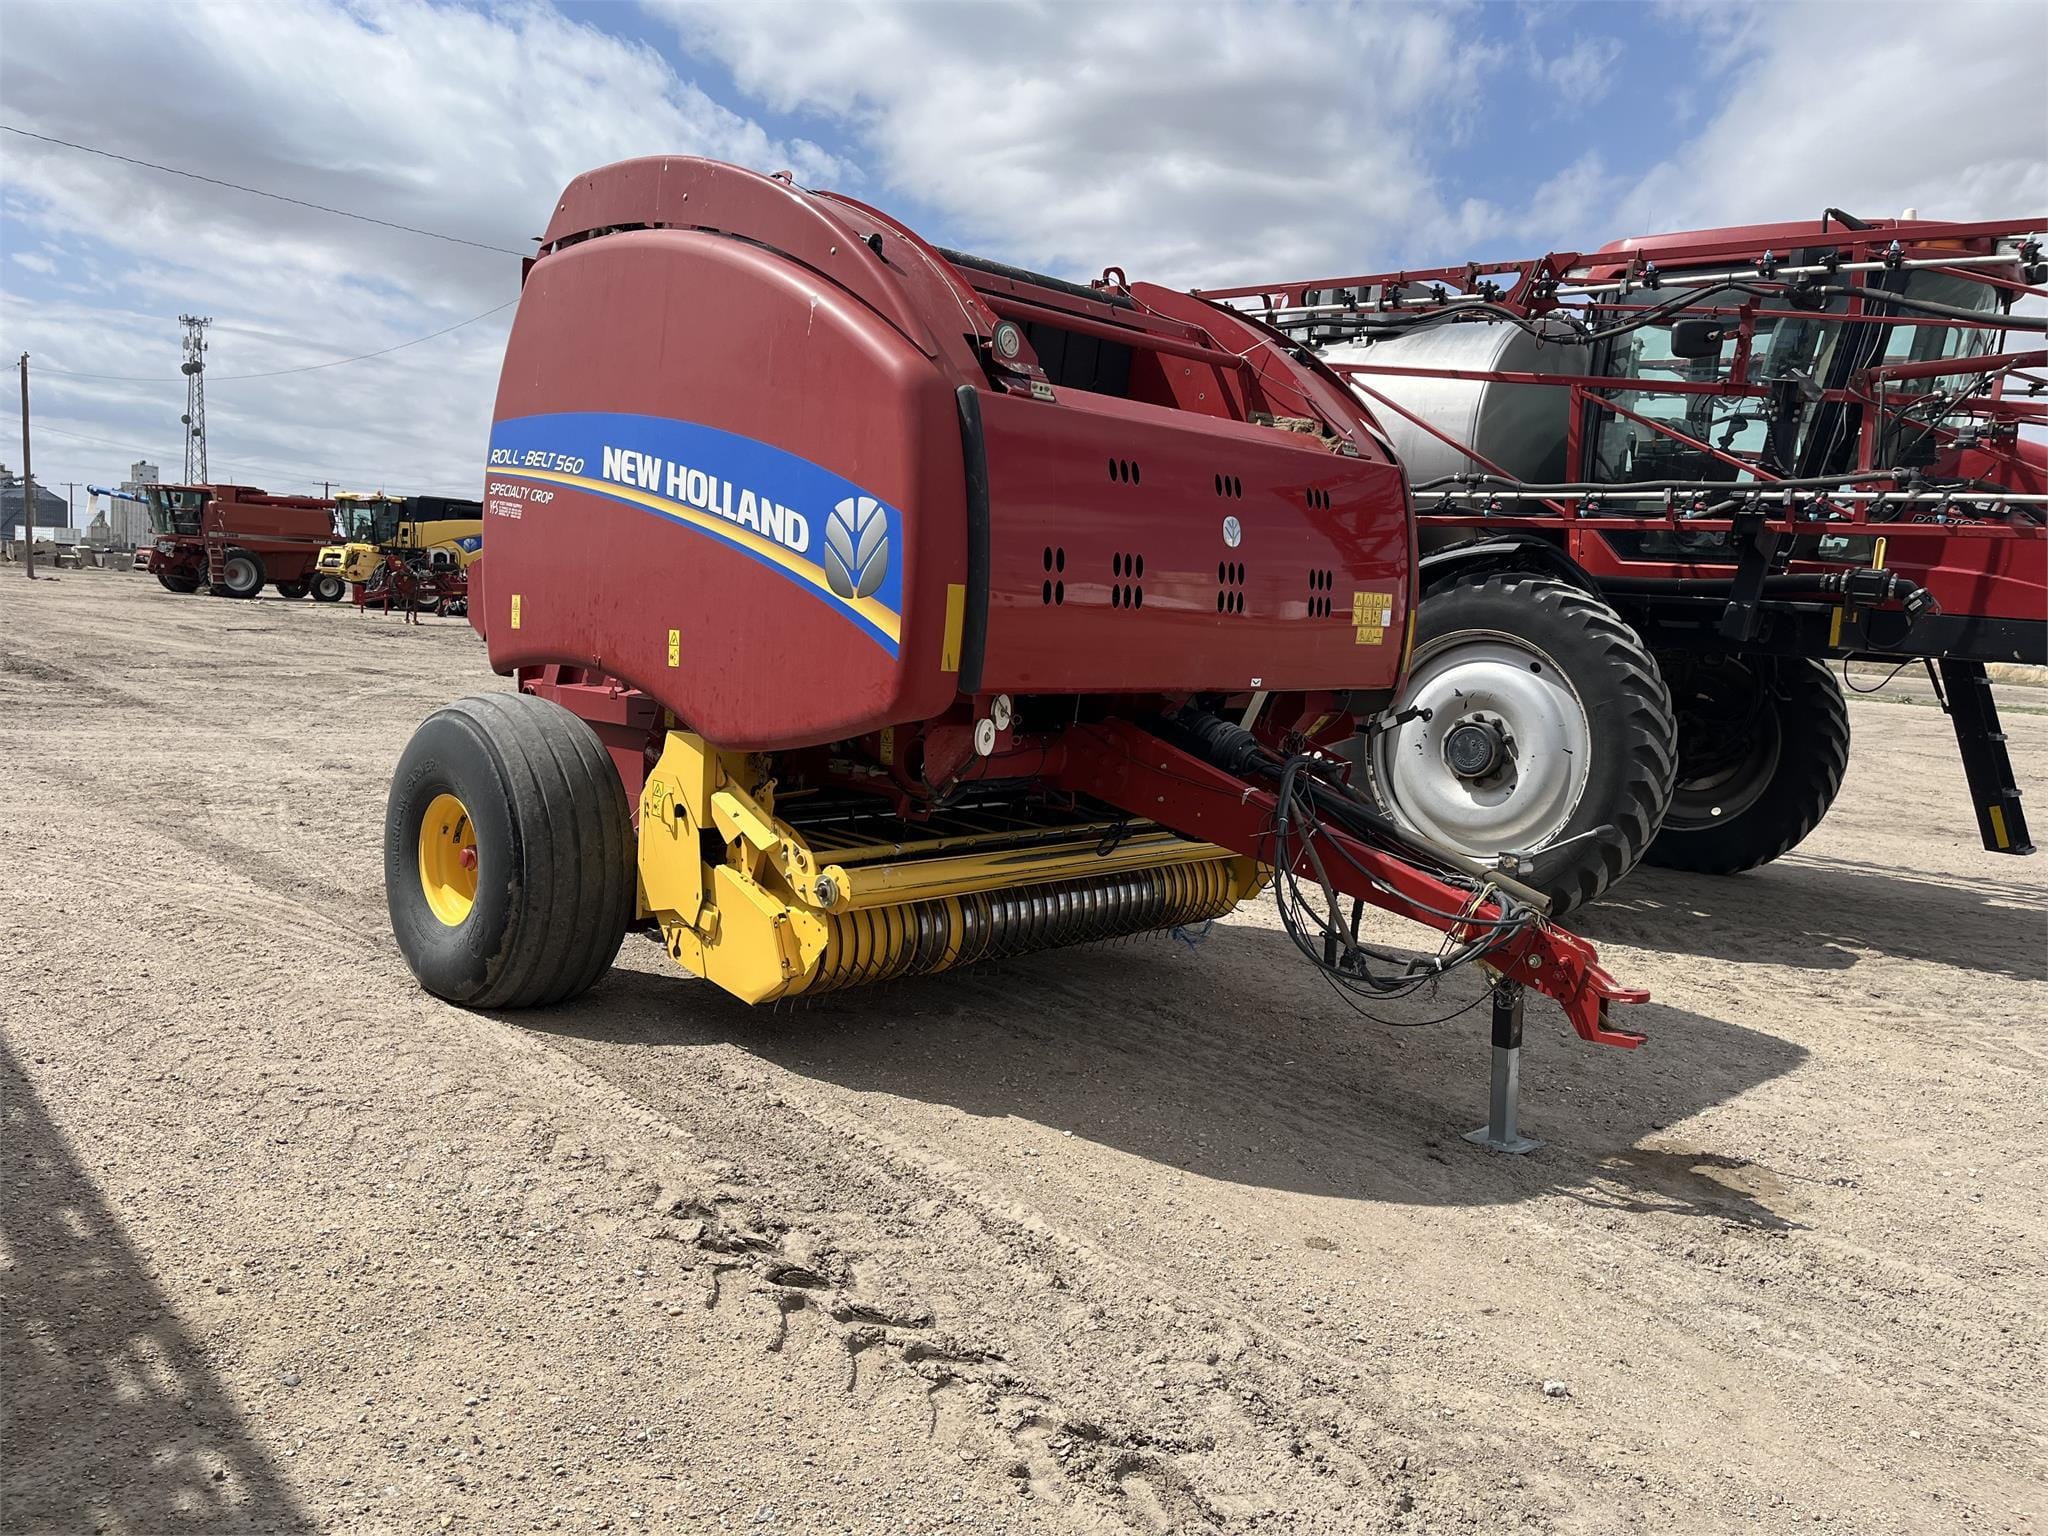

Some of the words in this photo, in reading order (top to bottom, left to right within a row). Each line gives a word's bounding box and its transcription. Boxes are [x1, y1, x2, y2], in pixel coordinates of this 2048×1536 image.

[490, 449, 556, 468] ROLL-BELT
[554, 455, 585, 475] 560
[489, 482, 531, 500] SPECIALTY
[530, 489, 554, 505] CROP
[603, 446, 662, 492] NEW
[666, 461, 810, 553] HOLLAND
